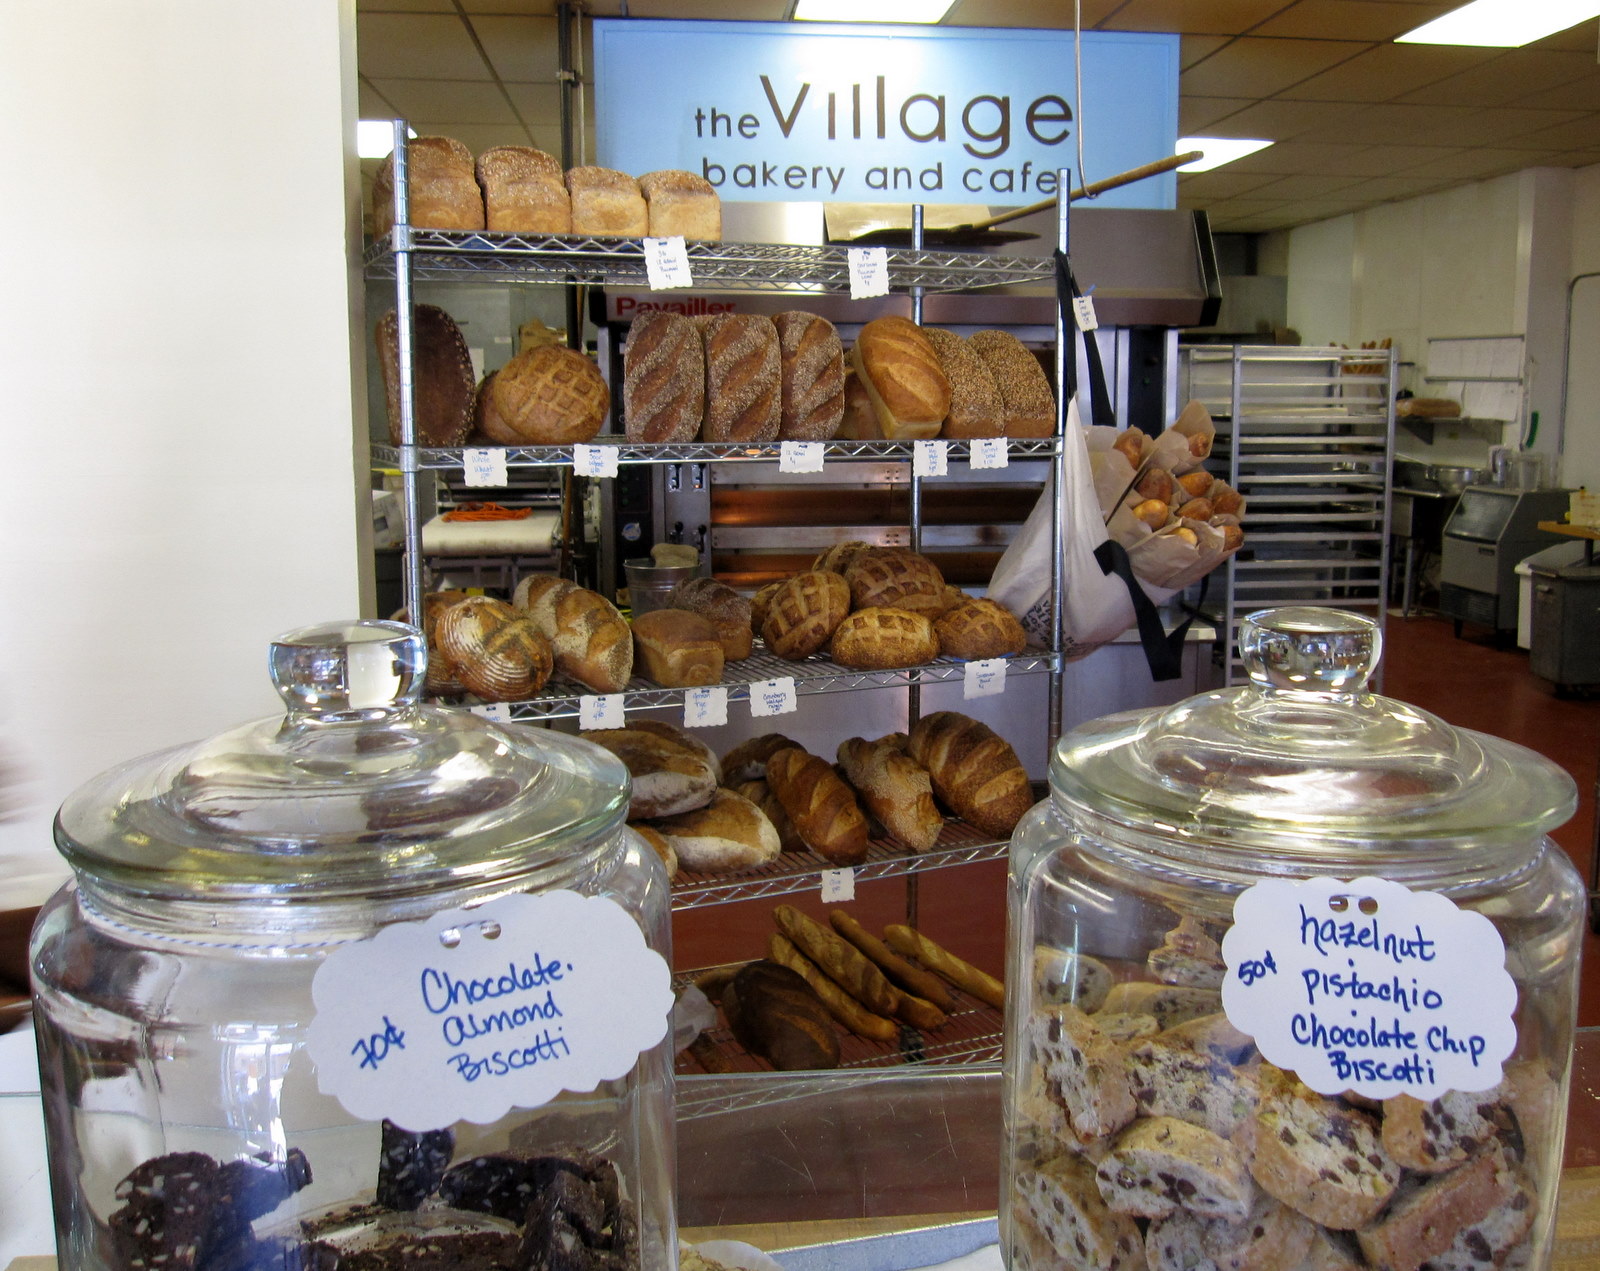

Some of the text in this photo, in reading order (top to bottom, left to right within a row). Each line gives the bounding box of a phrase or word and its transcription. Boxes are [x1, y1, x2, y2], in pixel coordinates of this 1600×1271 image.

[694, 74, 1073, 160] the Village
[702, 157, 1059, 194] bakery and cafe
[1291, 1013, 1418, 1050] Chocolate
[447, 1026, 570, 1083] Biscotti
[1327, 1050, 1436, 1084] Biscotti
